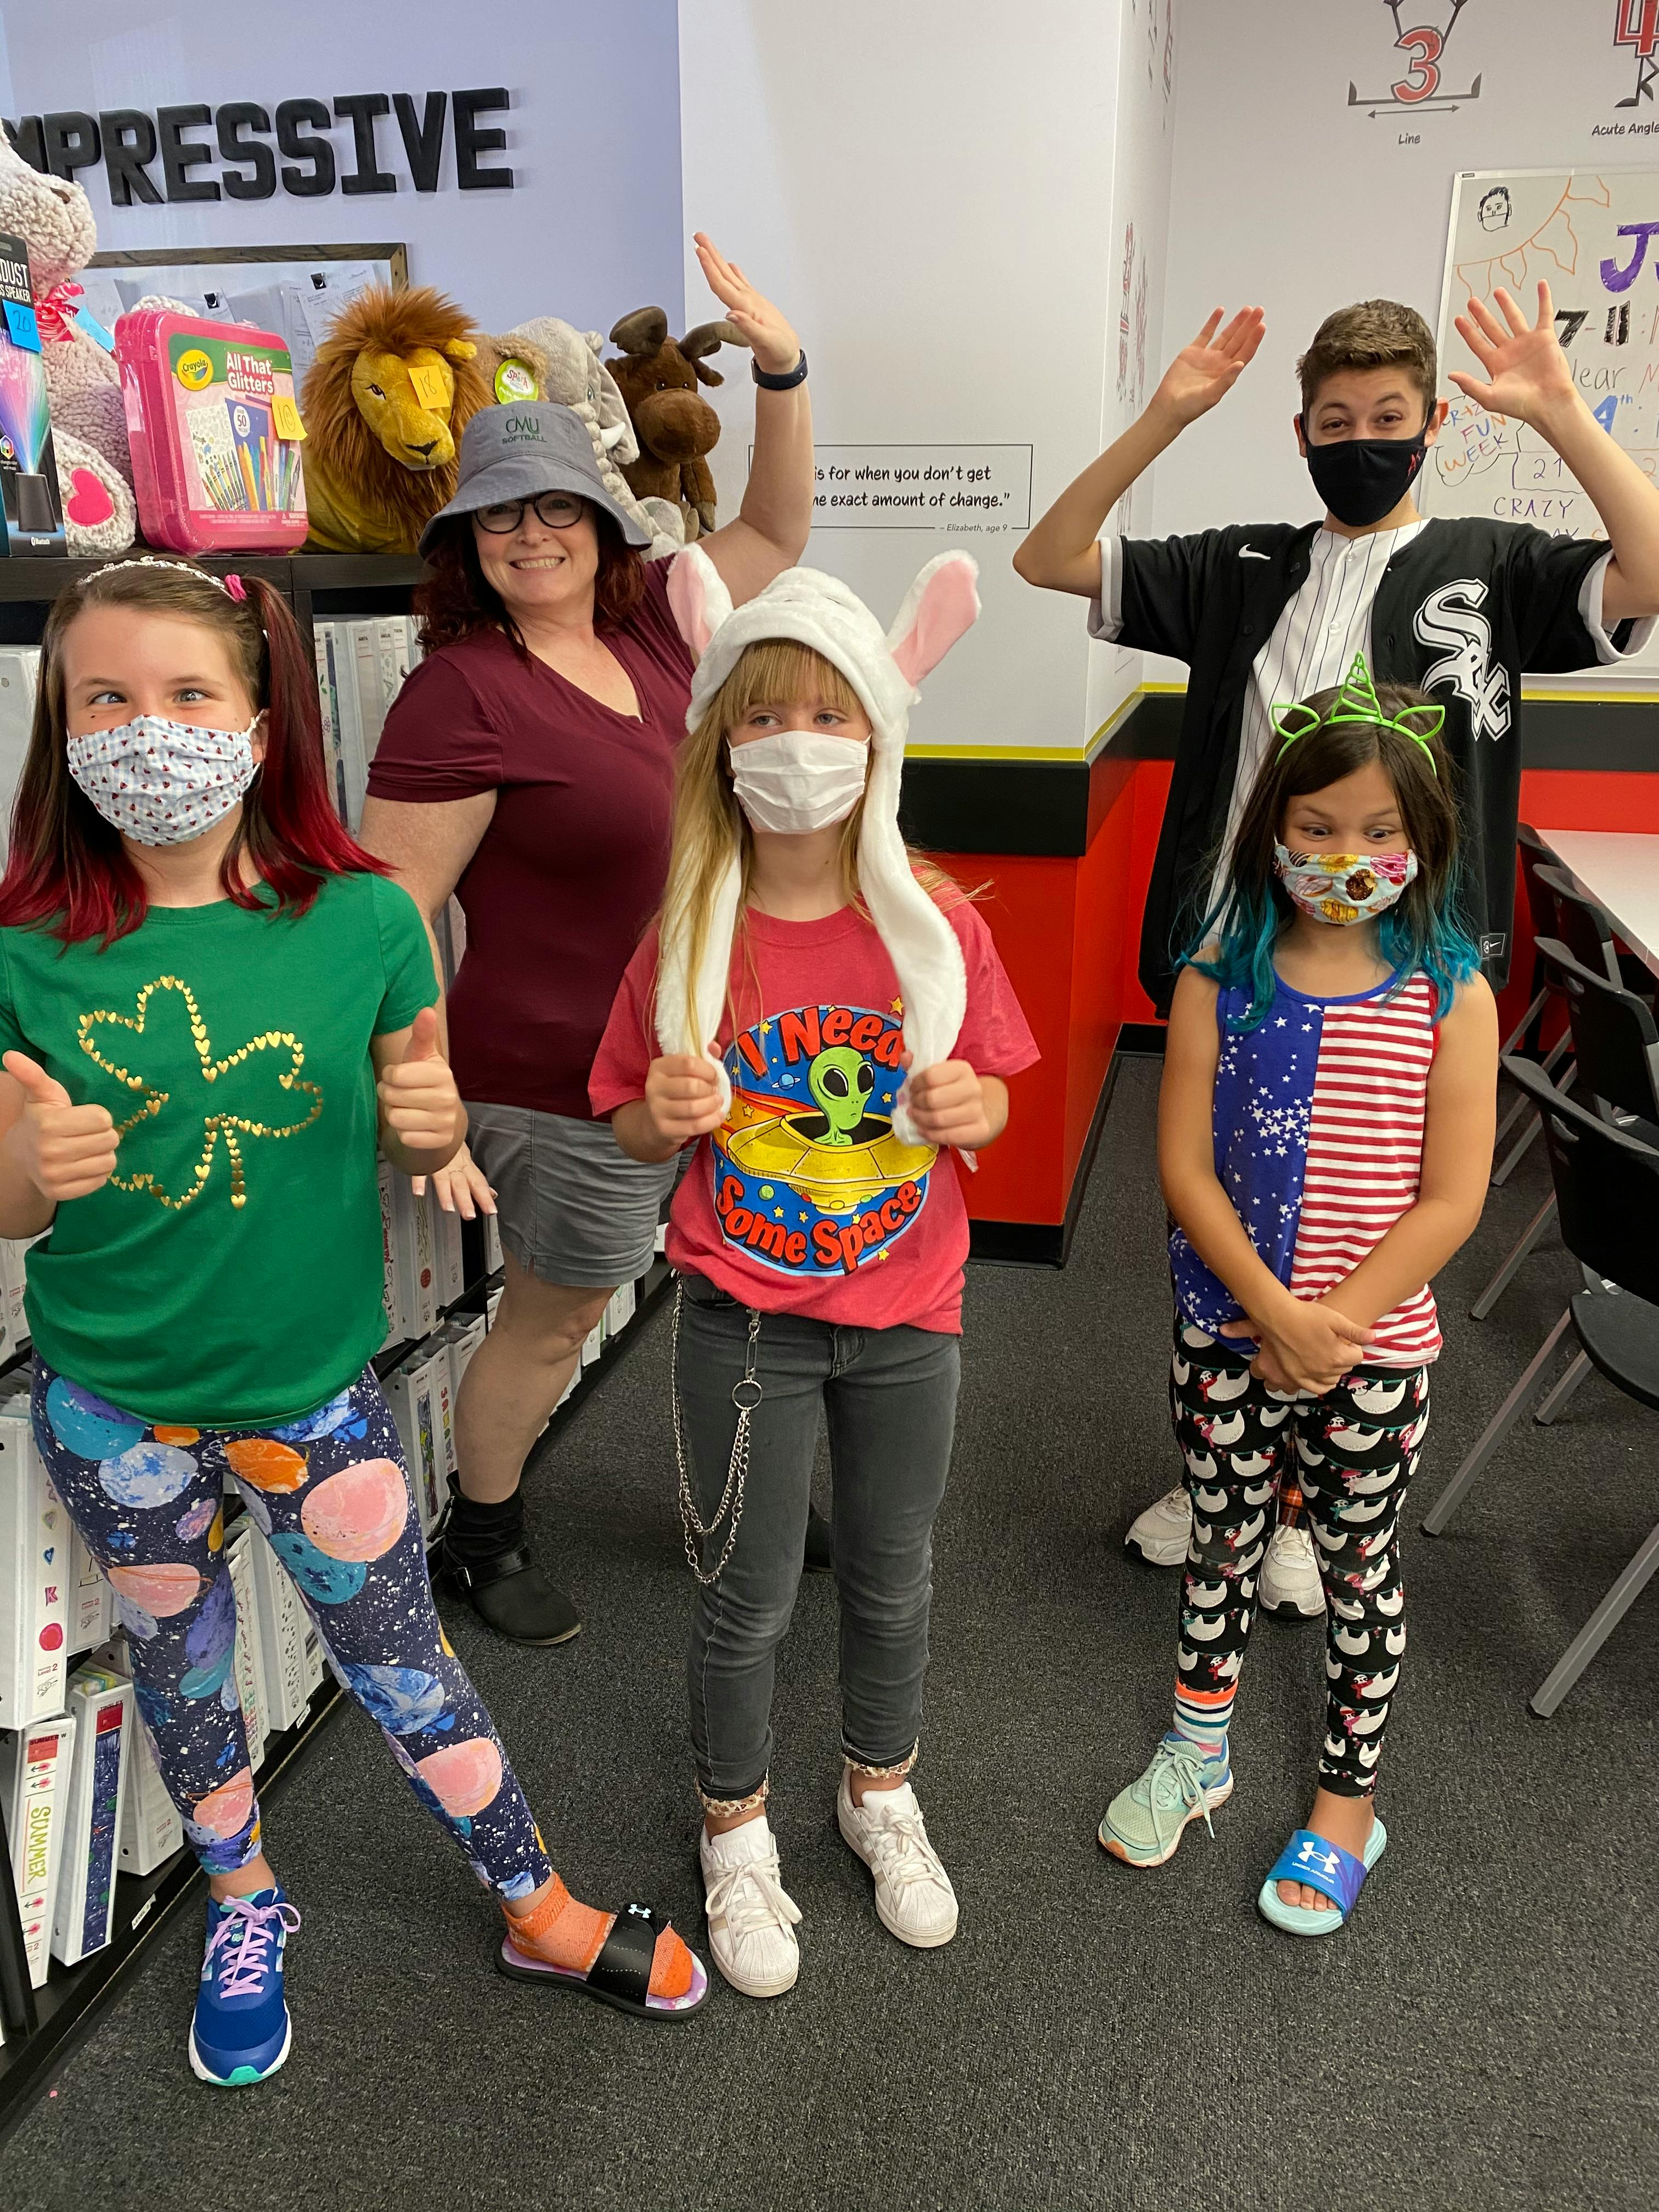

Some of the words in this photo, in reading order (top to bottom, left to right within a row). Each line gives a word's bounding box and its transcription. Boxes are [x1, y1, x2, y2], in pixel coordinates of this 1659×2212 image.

[1398, 132, 1421, 145] Line
[1591, 122, 1626, 136] Acute
[1628, 120, 1659, 135] Angle
[0, 258, 28, 289] DUST
[5, 285, 31, 303] SPEAKER
[13, 309, 31, 332] 20
[182, 358, 206, 372] Crayola
[226, 351, 241, 371] All
[242, 356, 272, 376] That
[228, 372, 274, 394] Glitters
[418, 368, 437, 398] 18
[506, 369, 529, 390] Spark
[236, 414, 247, 427] 50
[505, 415, 541, 434] CMU
[1442, 402, 1485, 426] RAZ
[1460, 414, 1507, 444] FUN
[501, 435, 548, 445] SOFTBALL
[1444, 432, 1509, 472] WEEK
[814, 465, 825, 481] is
[828, 465, 851, 481] for
[855, 465, 890, 481] when
[894, 467, 920, 483] you
[923, 465, 963, 481] don't
[967, 465, 991, 482] get
[1533, 457, 1562, 479] 21
[831, 492, 869, 506] exact
[872, 492, 926, 507] amount
[929, 492, 946, 507] of
[949, 492, 1010, 509] change."
[1494, 496, 1574, 520] CRAZY
[946, 523, 984, 533] Elizabeth,
[985, 525, 1000, 533] age
[1002, 523, 1008, 532] 9
[1413, 578, 1512, 742] Sox
[737, 1030, 769, 1079] I
[715, 1175, 808, 1264] Some
[811, 1180, 922, 1275] Space
[94, 1597, 100, 1606] 2
[52, 1663, 58, 1672] 2
[29, 1734, 60, 1746] SUMMER
[27, 1806, 52, 1884] SUMMER
